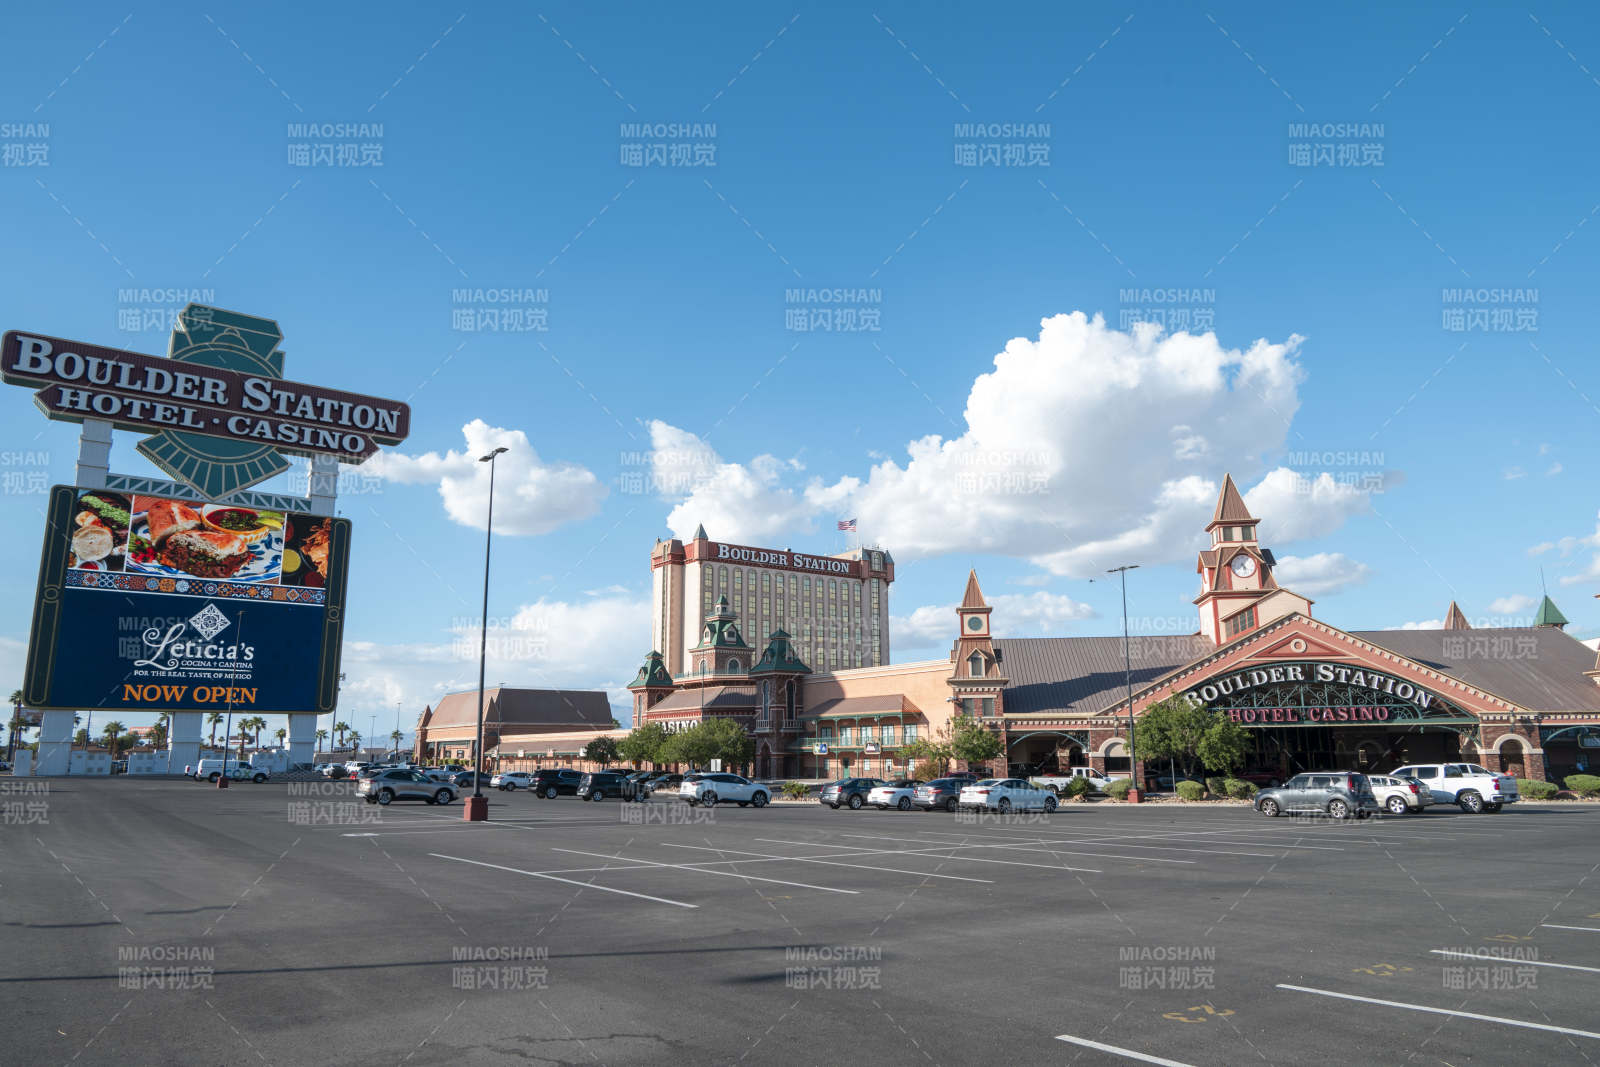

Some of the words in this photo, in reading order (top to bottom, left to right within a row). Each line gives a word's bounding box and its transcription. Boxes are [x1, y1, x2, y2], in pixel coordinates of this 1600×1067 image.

[12, 335, 229, 405] BOULDER
[241, 377, 401, 434] STATION
[56, 387, 205, 429] HOTEL
[227, 416, 366, 453] CASINO
[717, 543, 788, 566] BOULDER
[793, 554, 850, 573] STATION
[133, 623, 255, 671] Leticia's
[181, 660, 212, 668] COCINA
[218, 661, 253, 669] CANTINA
[122, 684, 189, 702] NOW
[192, 686, 259, 704] OPEN
[1316, 664, 1435, 709] STATION
[1227, 708, 1300, 723] HOTEL
[1309, 706, 1390, 722] CASINO
